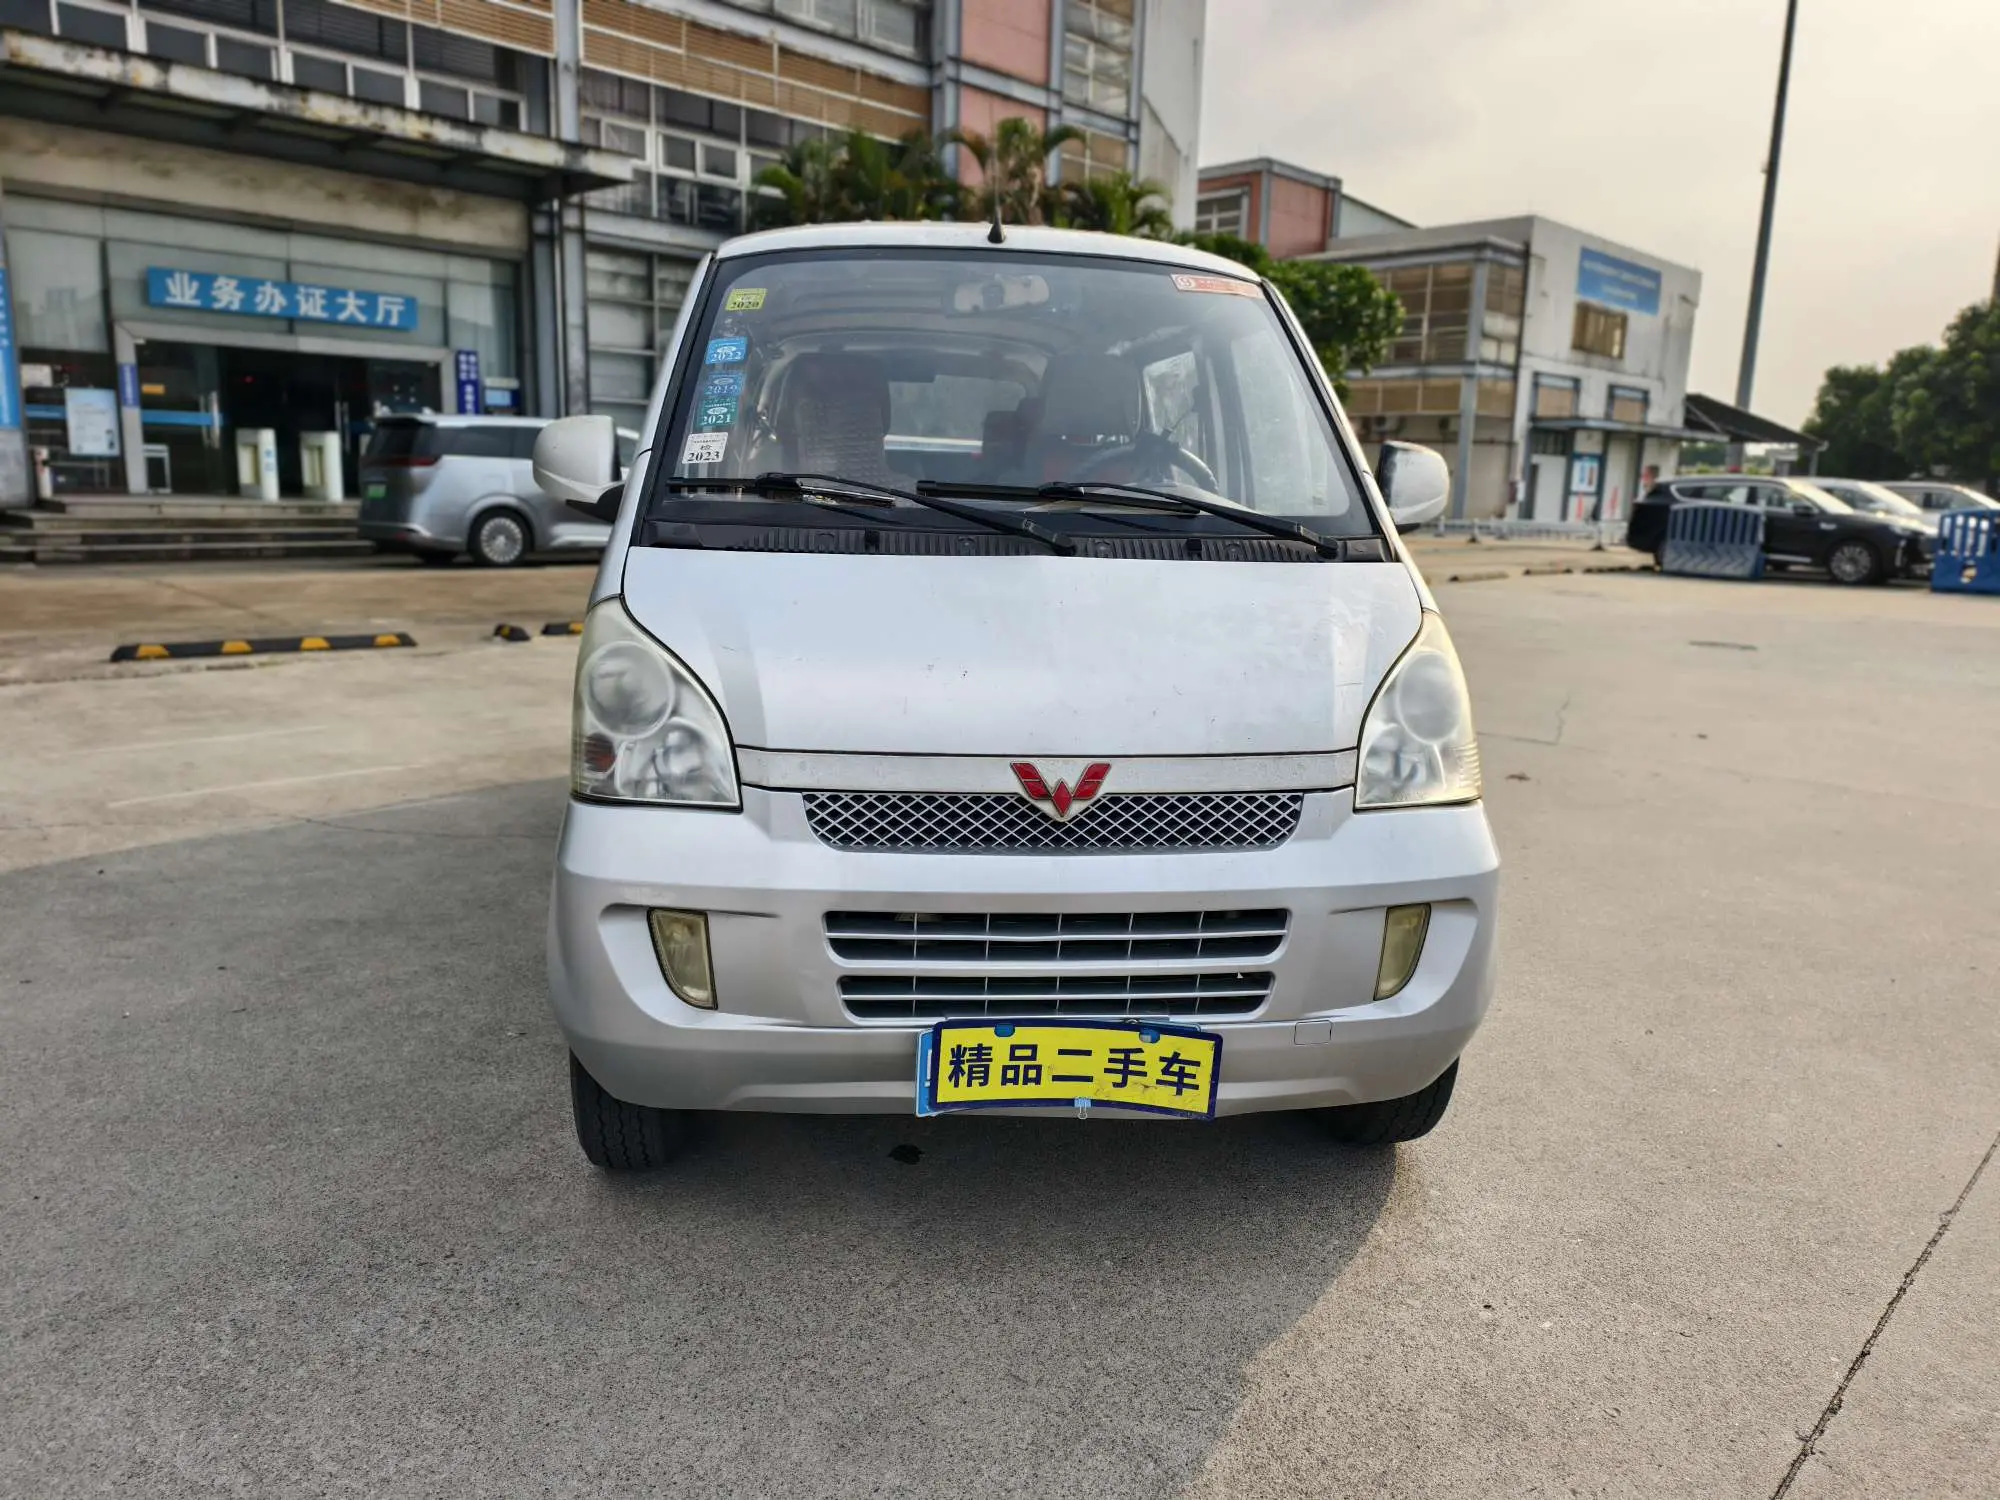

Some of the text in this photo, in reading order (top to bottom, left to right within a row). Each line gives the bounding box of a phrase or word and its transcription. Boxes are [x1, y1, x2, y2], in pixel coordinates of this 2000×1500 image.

[165, 272, 405, 326] 业务办证大厅
[730, 301, 760, 309] 2020
[711, 351, 742, 363] 2022
[704, 384, 738, 395] 2019
[701, 414, 732, 425] 2021
[687, 451, 720, 461] 2023
[948, 1043, 1201, 1096] 精品二手车
